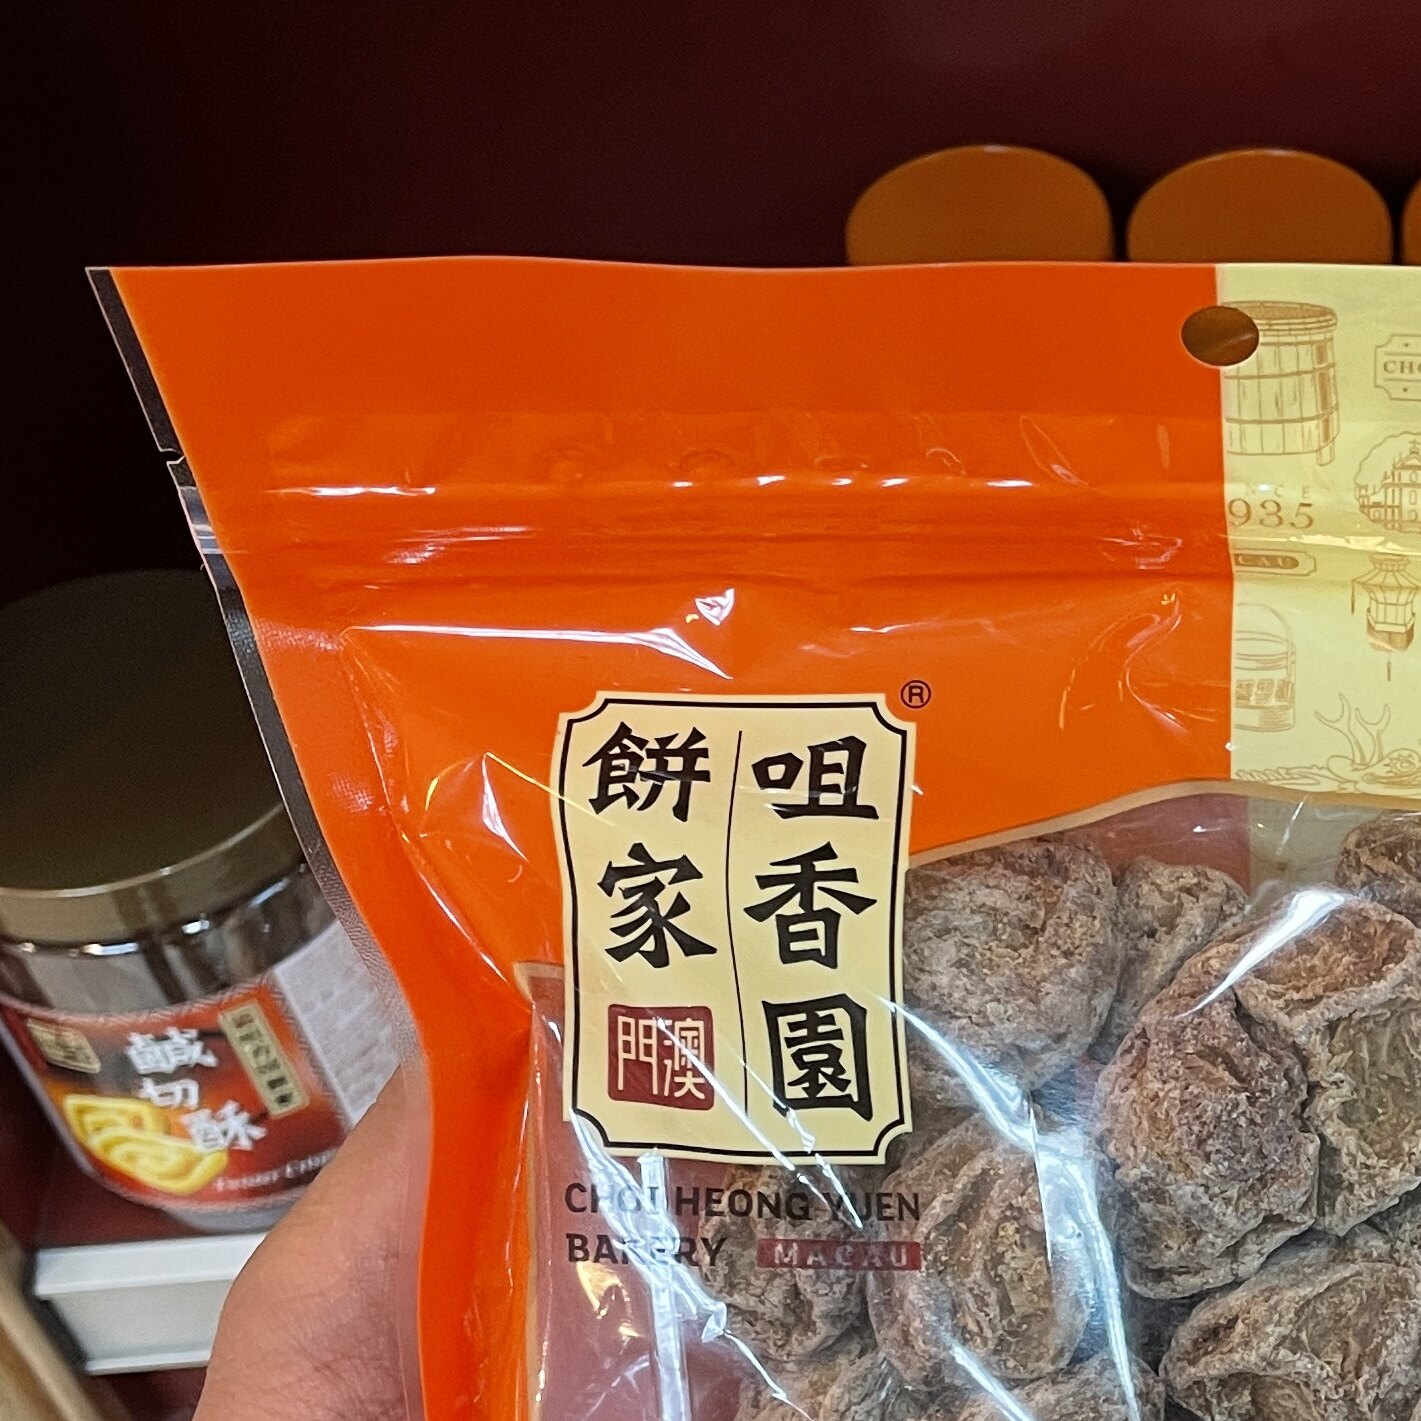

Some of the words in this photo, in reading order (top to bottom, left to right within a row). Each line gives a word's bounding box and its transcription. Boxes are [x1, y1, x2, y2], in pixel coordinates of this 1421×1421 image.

[582, 721, 718, 968] 餅家
[742, 735, 879, 1121] 咀香園
[675, 1186, 815, 1221] HEONG
[825, 1191, 921, 1224] YUEN
[773, 1242, 908, 1268] MACAU
